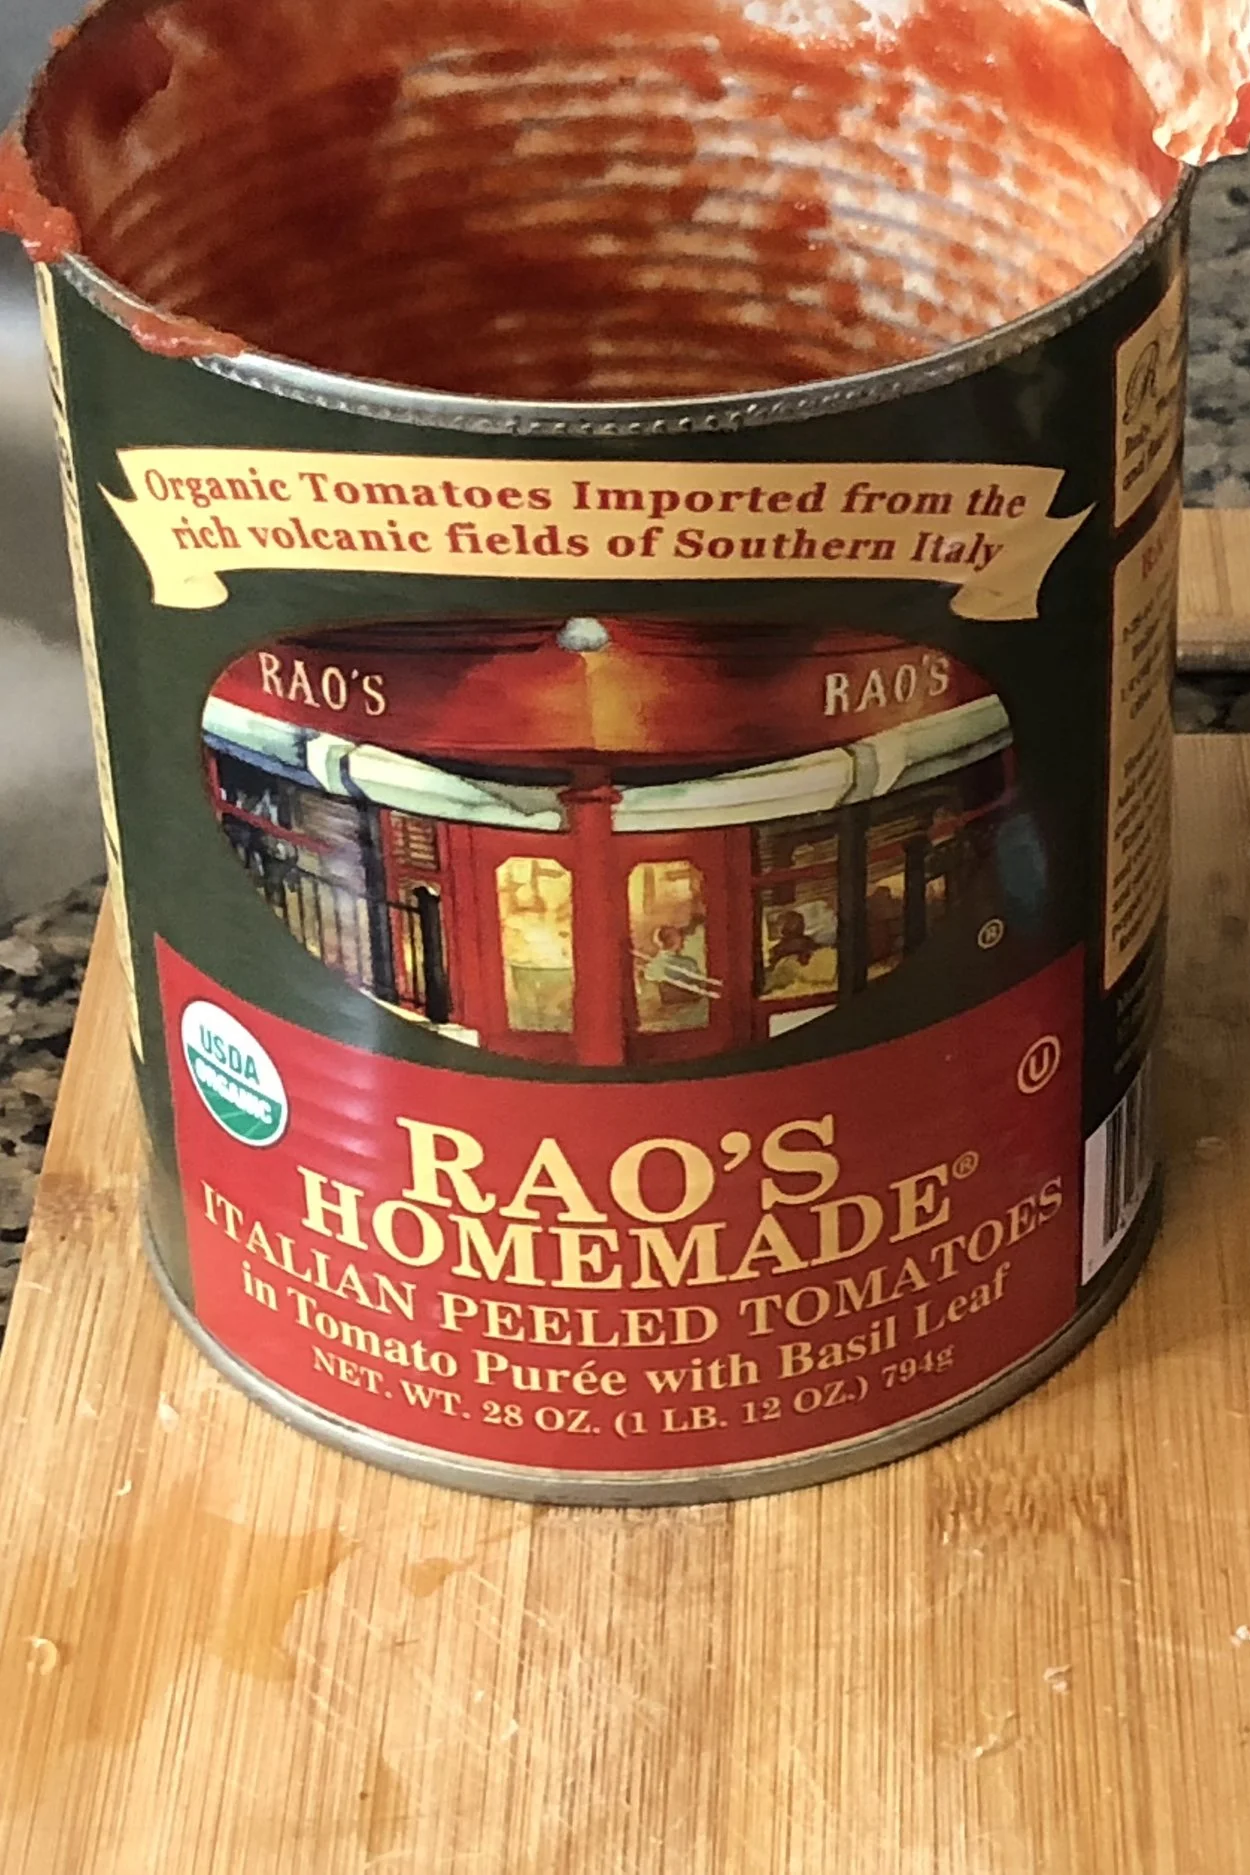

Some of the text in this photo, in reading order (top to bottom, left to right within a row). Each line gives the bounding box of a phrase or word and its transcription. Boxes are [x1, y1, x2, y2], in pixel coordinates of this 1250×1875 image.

[145, 467, 1026, 519] Organic Tomatoes Imported from the
[173, 515, 1004, 572] rich volcanic fields of Southern Italy
[257, 651, 388, 717] RAO'S
[823, 654, 952, 717] RAO'S
[199, 1023, 261, 1087] USDA
[396, 1113, 841, 1226] RAO'S
[200, 1175, 1064, 1349] ITALIAN PEELED TOMATOES
[241, 1260, 1012, 1396] in Tomato Purée with Basil Leaf
[311, 1343, 956, 1441] NET. WT. 28 OZ. (1 LB. 12 OZ.) 794g
